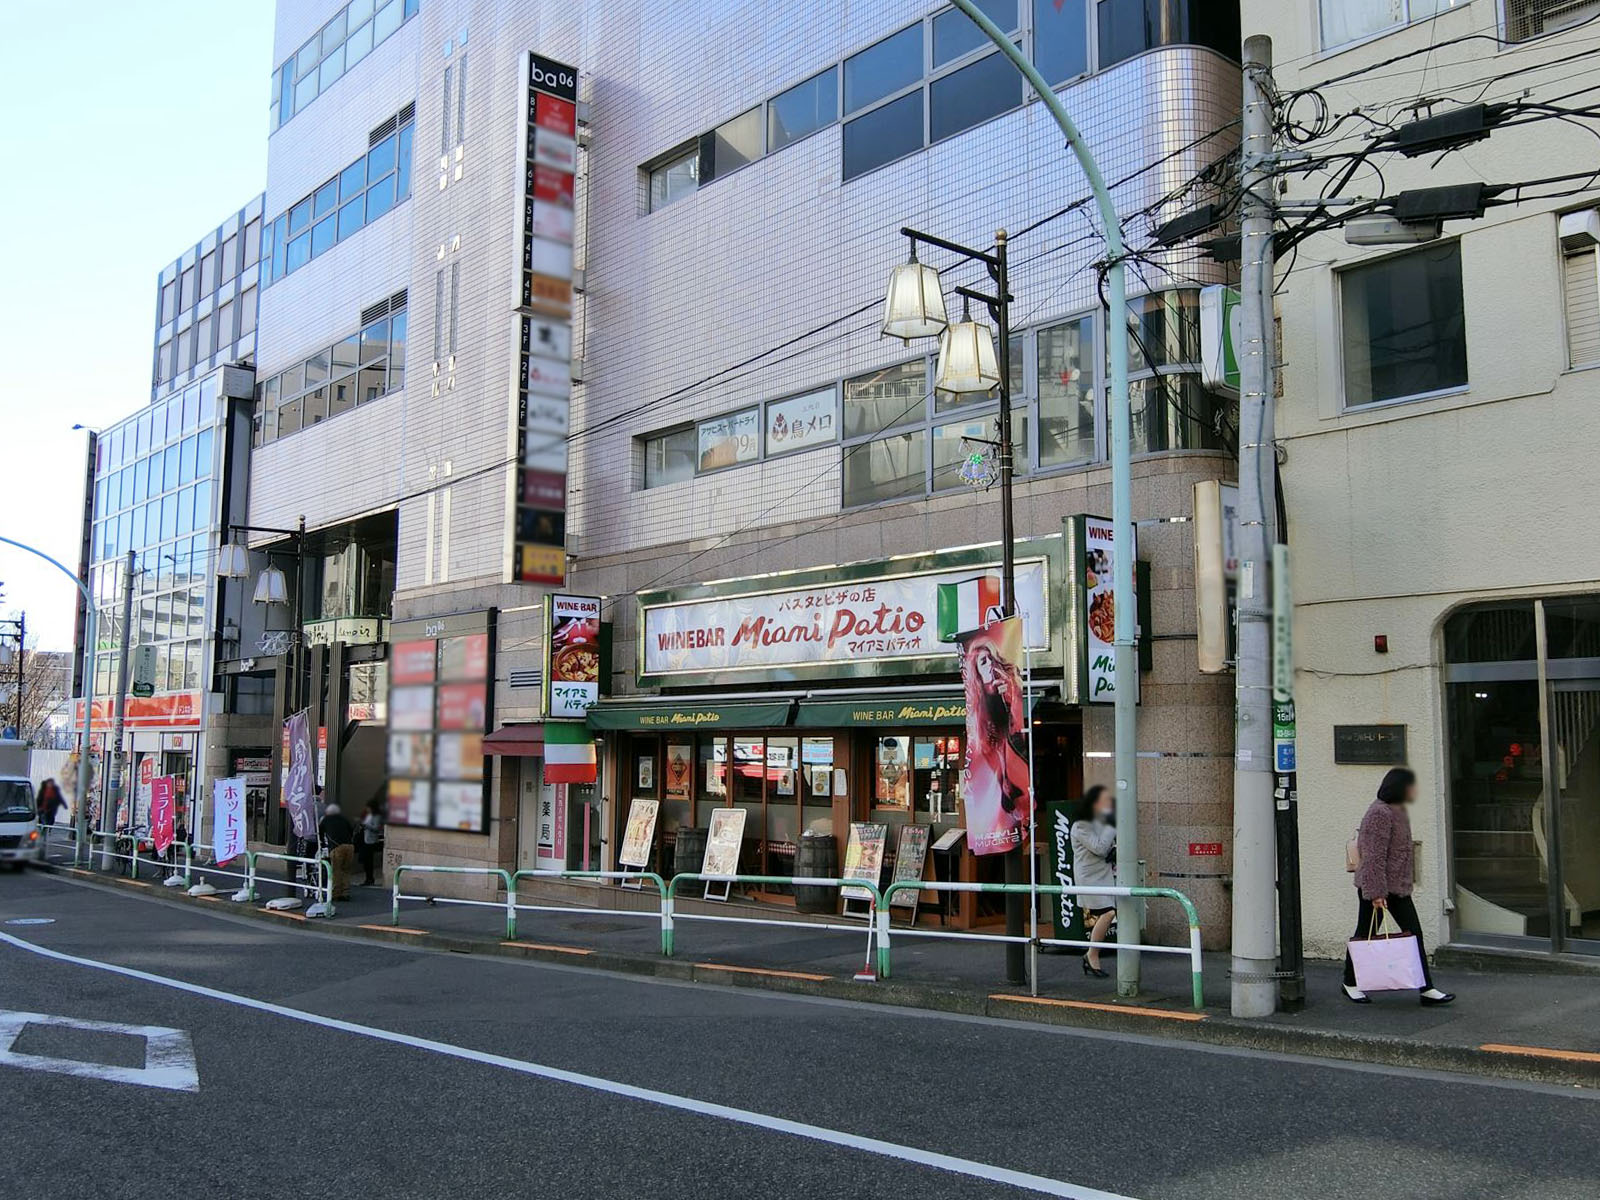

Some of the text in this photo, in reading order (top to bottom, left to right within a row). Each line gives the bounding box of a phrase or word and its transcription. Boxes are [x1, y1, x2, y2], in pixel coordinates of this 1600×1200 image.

[531, 62, 574, 88] ba06
[790, 414, 832, 440] 鳥メロ
[1088, 526, 1114, 542] WINE
[556, 601, 598, 612] WINE BAR
[731, 612, 823, 649] Miami
[827, 602, 926, 649] Patio
[554, 688, 588, 699] マイアミ
[639, 716, 655, 725] WINE
[656, 716, 669, 725] BAR
[694, 712, 720, 725] Patio
[852, 711, 874, 720] WINE
[876, 711, 895, 720] BAR
[898, 706, 934, 719] Miami
[157, 783, 169, 852] コラーゲン
[223, 786, 239, 857] ホットヨガ
[1054, 809, 1071, 873] Miami
